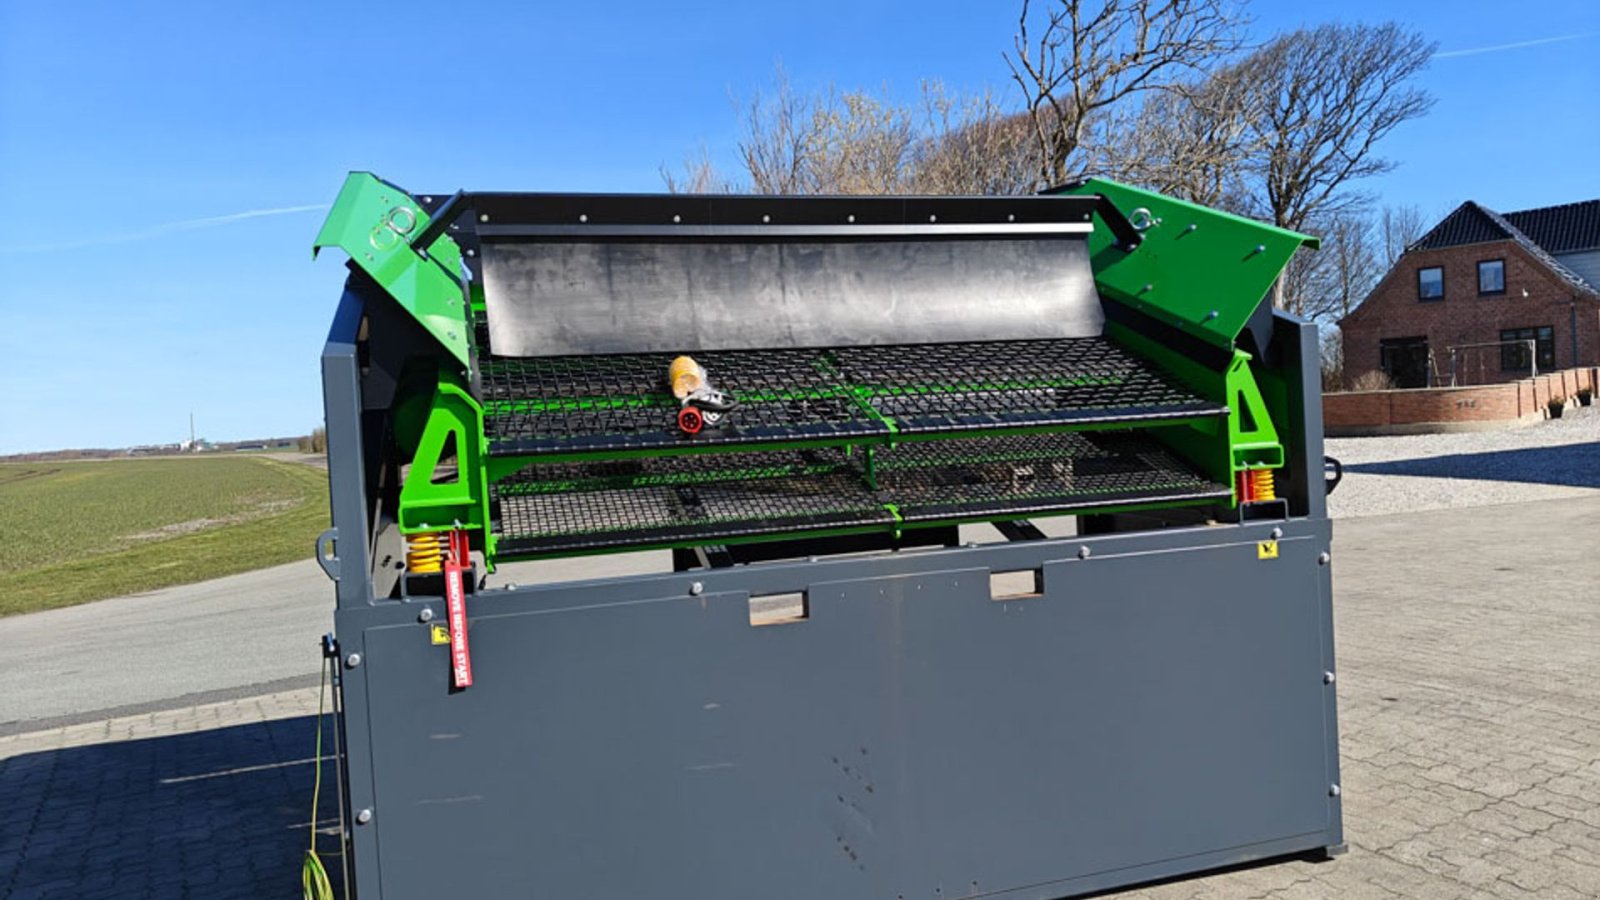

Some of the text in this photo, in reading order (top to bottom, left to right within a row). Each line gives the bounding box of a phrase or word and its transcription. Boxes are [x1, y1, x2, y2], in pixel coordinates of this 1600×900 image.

[449, 571, 461, 612] REMOVE
[453, 613, 464, 651] BEFORE
[456, 652, 468, 684] START
